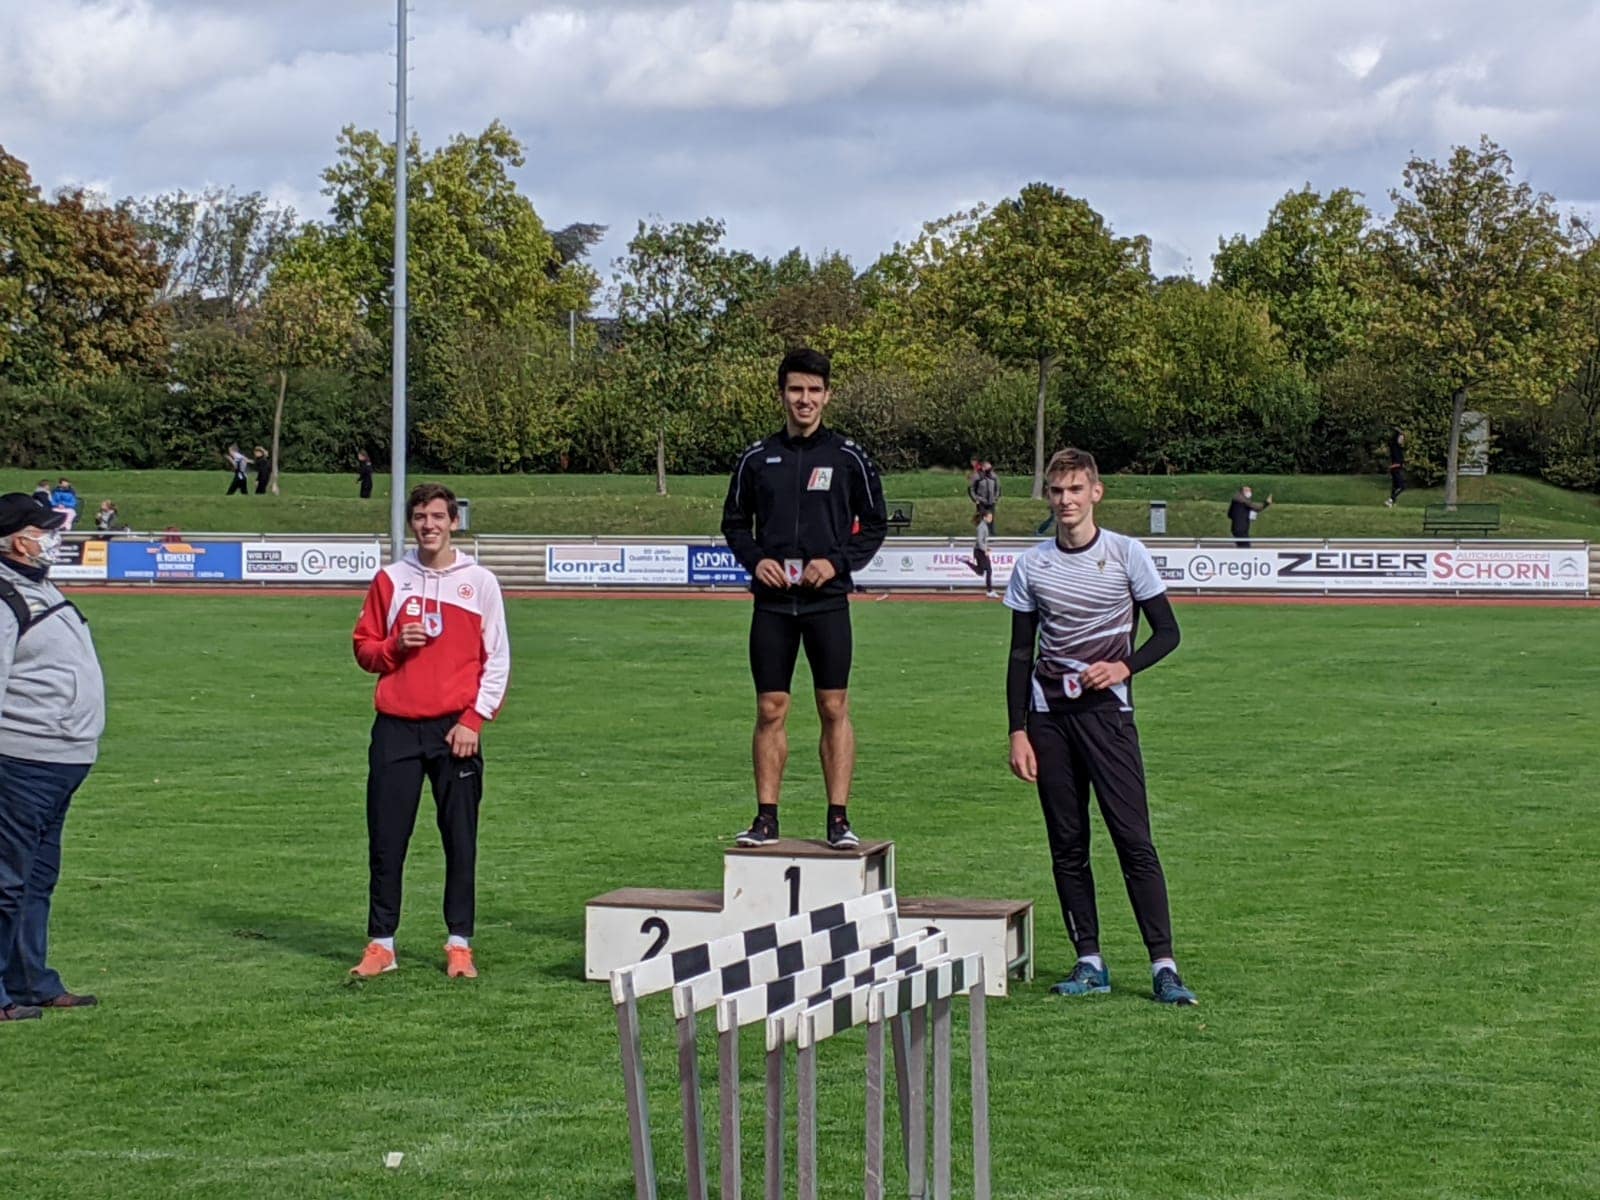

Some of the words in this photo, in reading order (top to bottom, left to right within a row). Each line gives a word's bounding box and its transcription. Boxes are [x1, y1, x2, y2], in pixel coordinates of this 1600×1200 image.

[549, 547, 624, 573] konrad
[1277, 552, 1427, 577] ZEIGER
[1433, 552, 1550, 579] SCHORN
[784, 866, 800, 917] 1
[640, 917, 670, 961] 2
